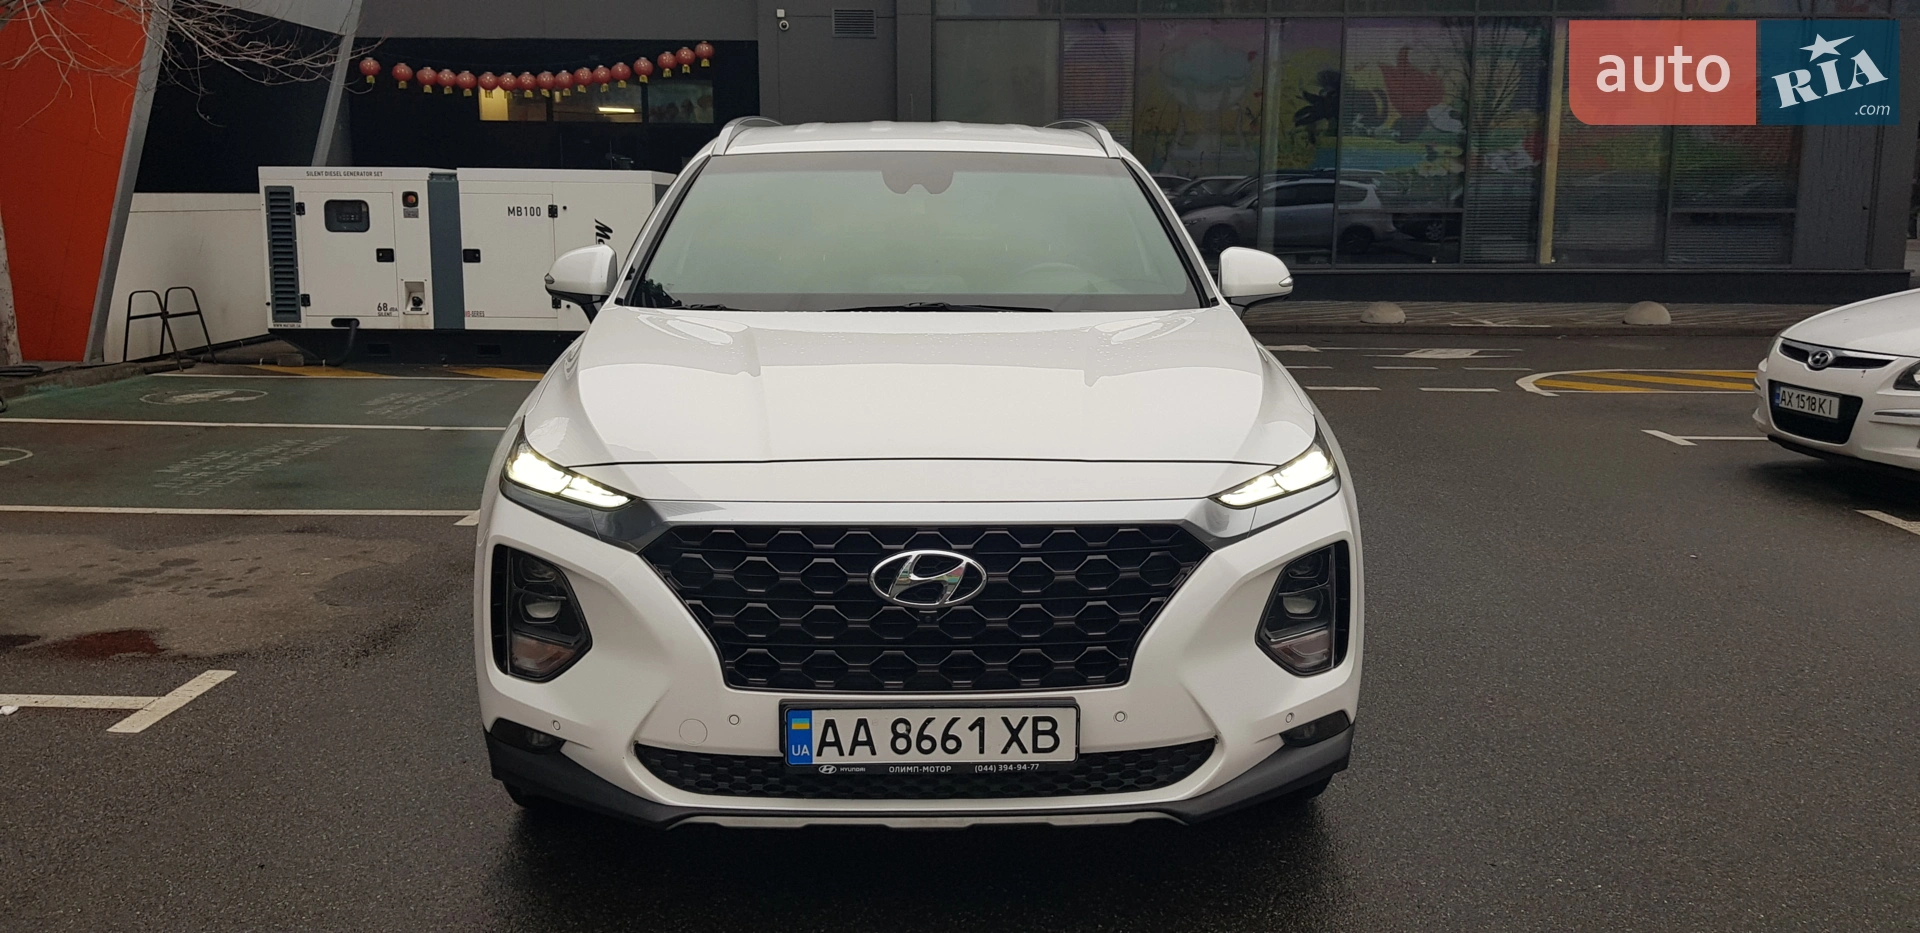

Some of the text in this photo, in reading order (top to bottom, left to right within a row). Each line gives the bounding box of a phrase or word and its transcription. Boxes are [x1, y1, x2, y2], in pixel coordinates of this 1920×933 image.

[507, 206, 541, 217] MB100
[377, 302, 388, 312] 68
[1780, 390, 1832, 415] AX 1518 KI
[791, 716, 1060, 757] UA AA 8661 XB
[888, 765, 952, 773] ОЛИМП-МОТОР
[974, 764, 996, 773] (044)
[998, 763, 1040, 772] 394-94-77
